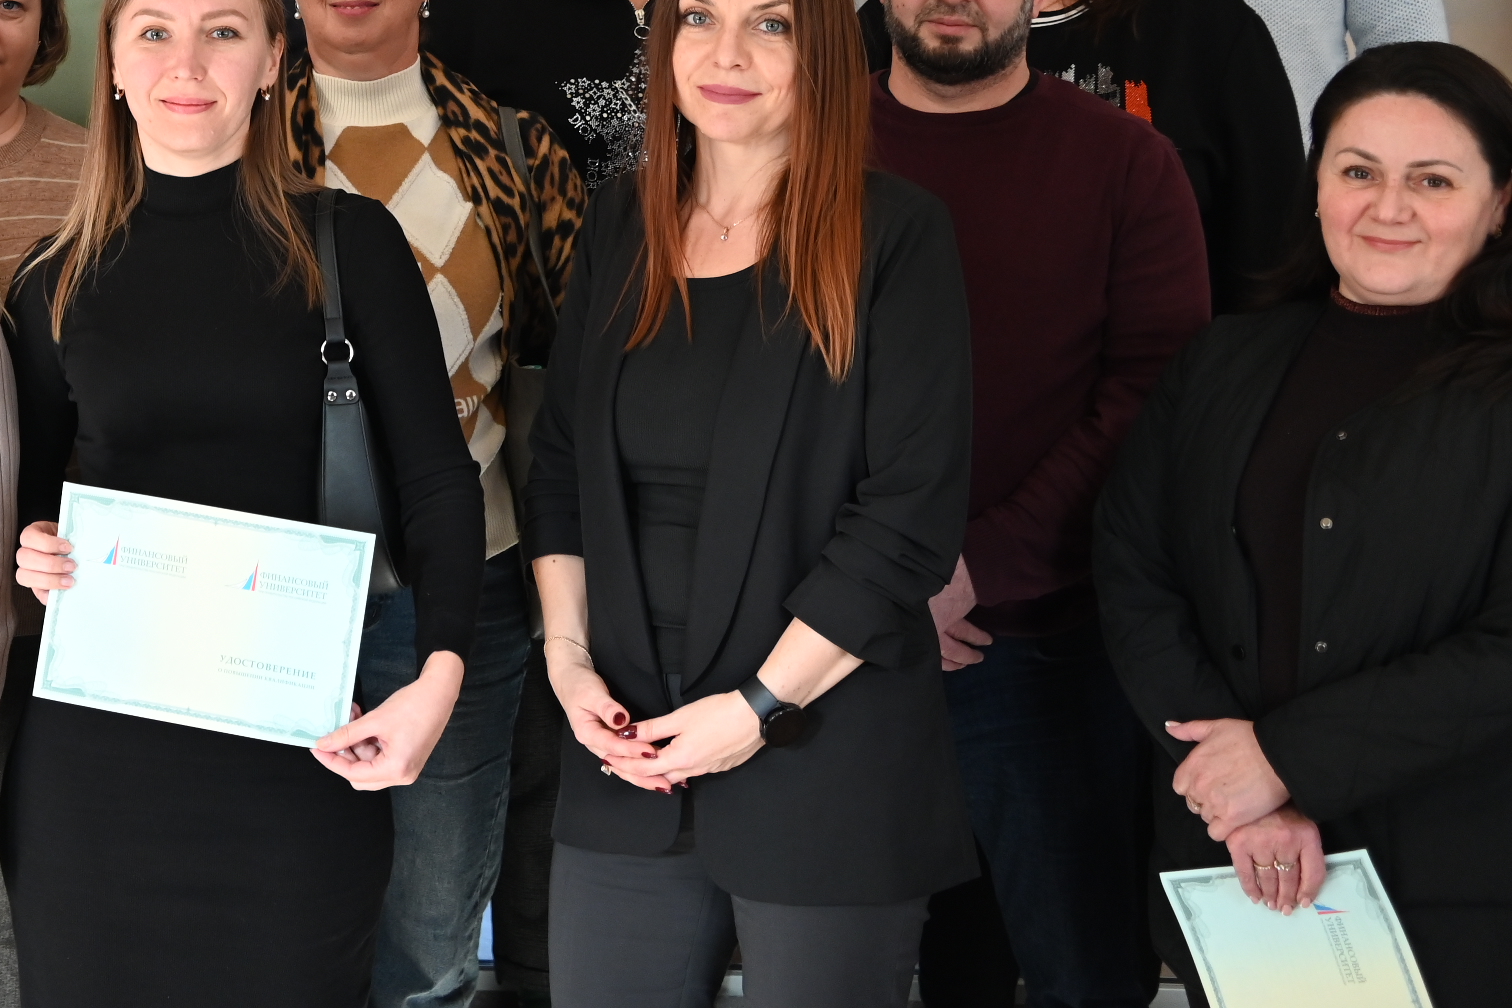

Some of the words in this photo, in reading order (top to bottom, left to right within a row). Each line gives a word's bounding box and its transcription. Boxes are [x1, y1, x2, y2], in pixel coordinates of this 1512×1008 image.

[120, 555, 187, 574] УНИВЕРСИТЕТ
[121, 546, 188, 565] ФИНАНСОВЫЙ
[259, 572, 329, 590] ФИНАНСОВЫЙ
[259, 581, 328, 600] УНИВЕРСИТЕТ
[220, 654, 317, 680] УДОСТОВЕРЕНИЕ
